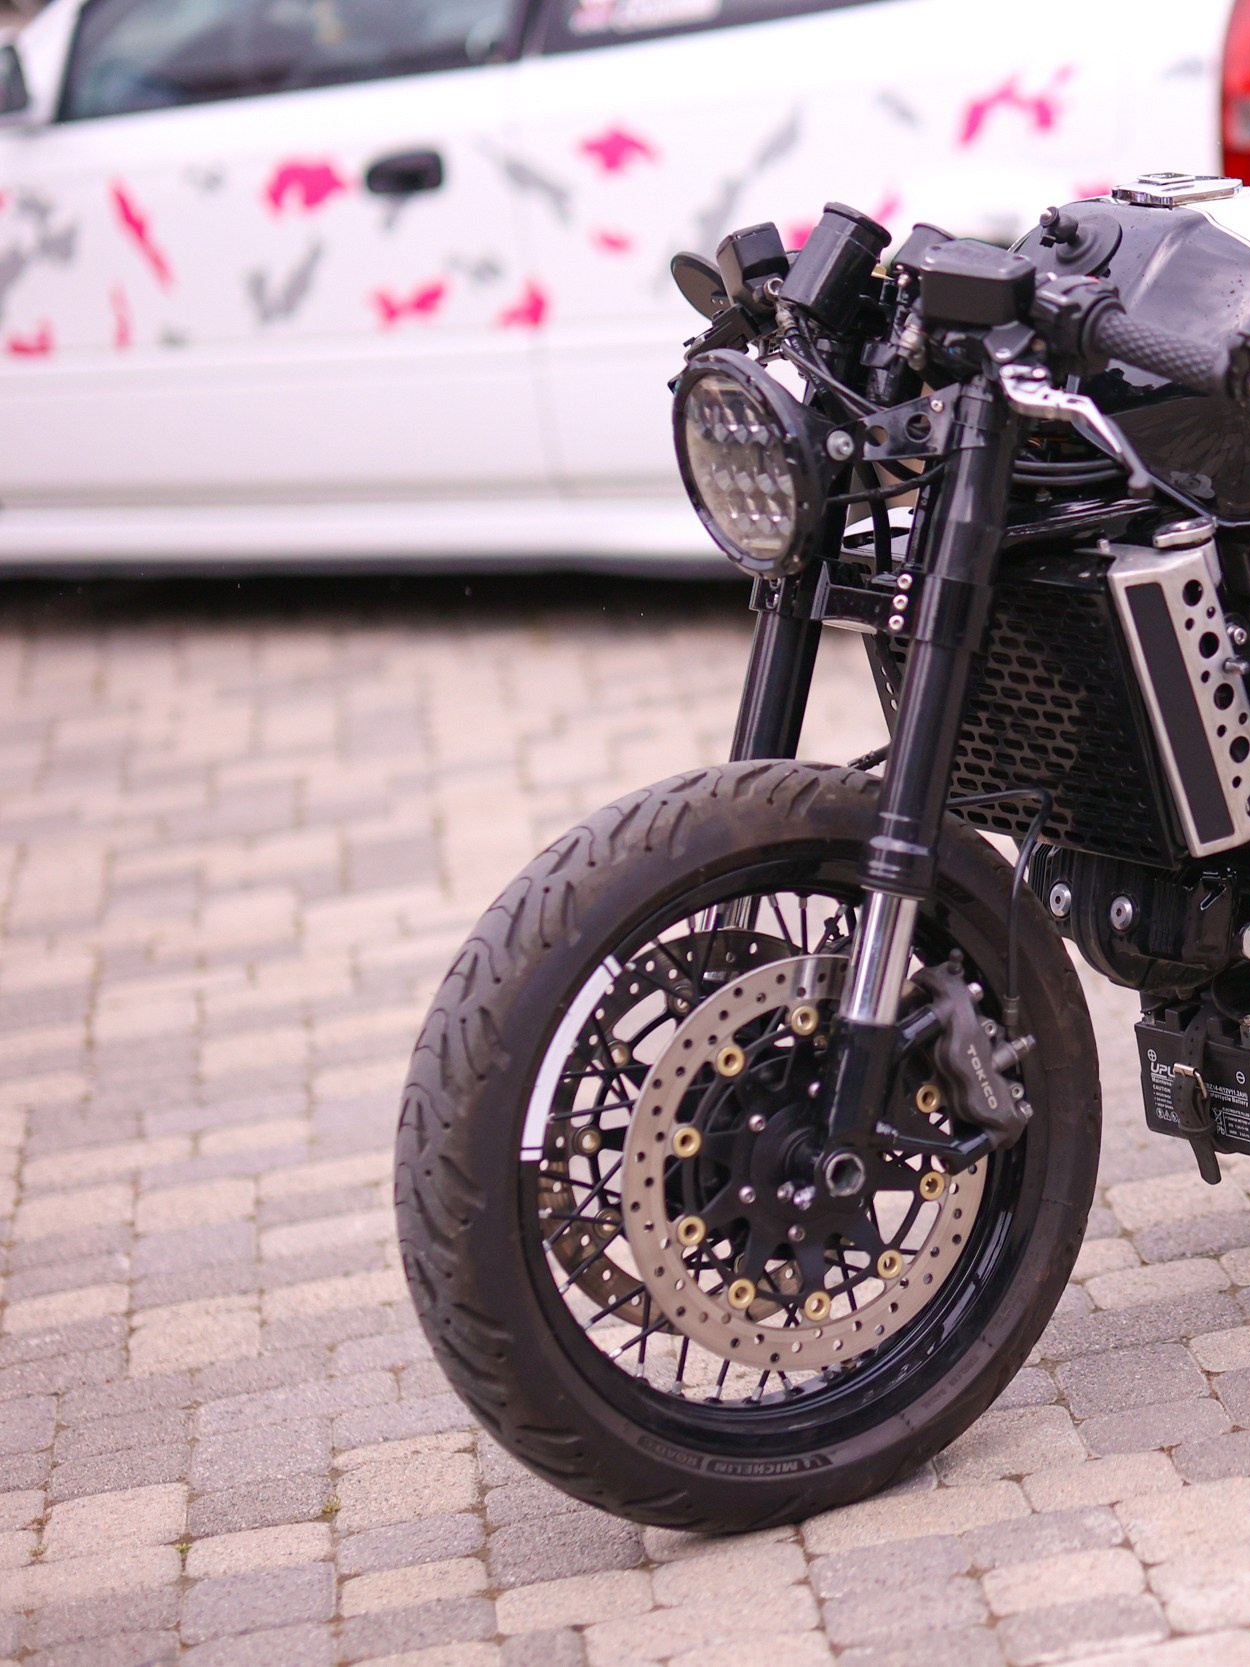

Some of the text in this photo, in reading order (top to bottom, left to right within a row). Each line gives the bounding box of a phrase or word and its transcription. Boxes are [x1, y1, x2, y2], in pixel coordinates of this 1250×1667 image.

[967, 1044, 998, 1110] TOKICO
[1151, 1062, 1175, 1078] UPL
[1210, 1092, 1231, 1102] otorcycle
[1217, 1125, 1226, 1136] Pb
[714, 1459, 798, 1476] MICHELIN
